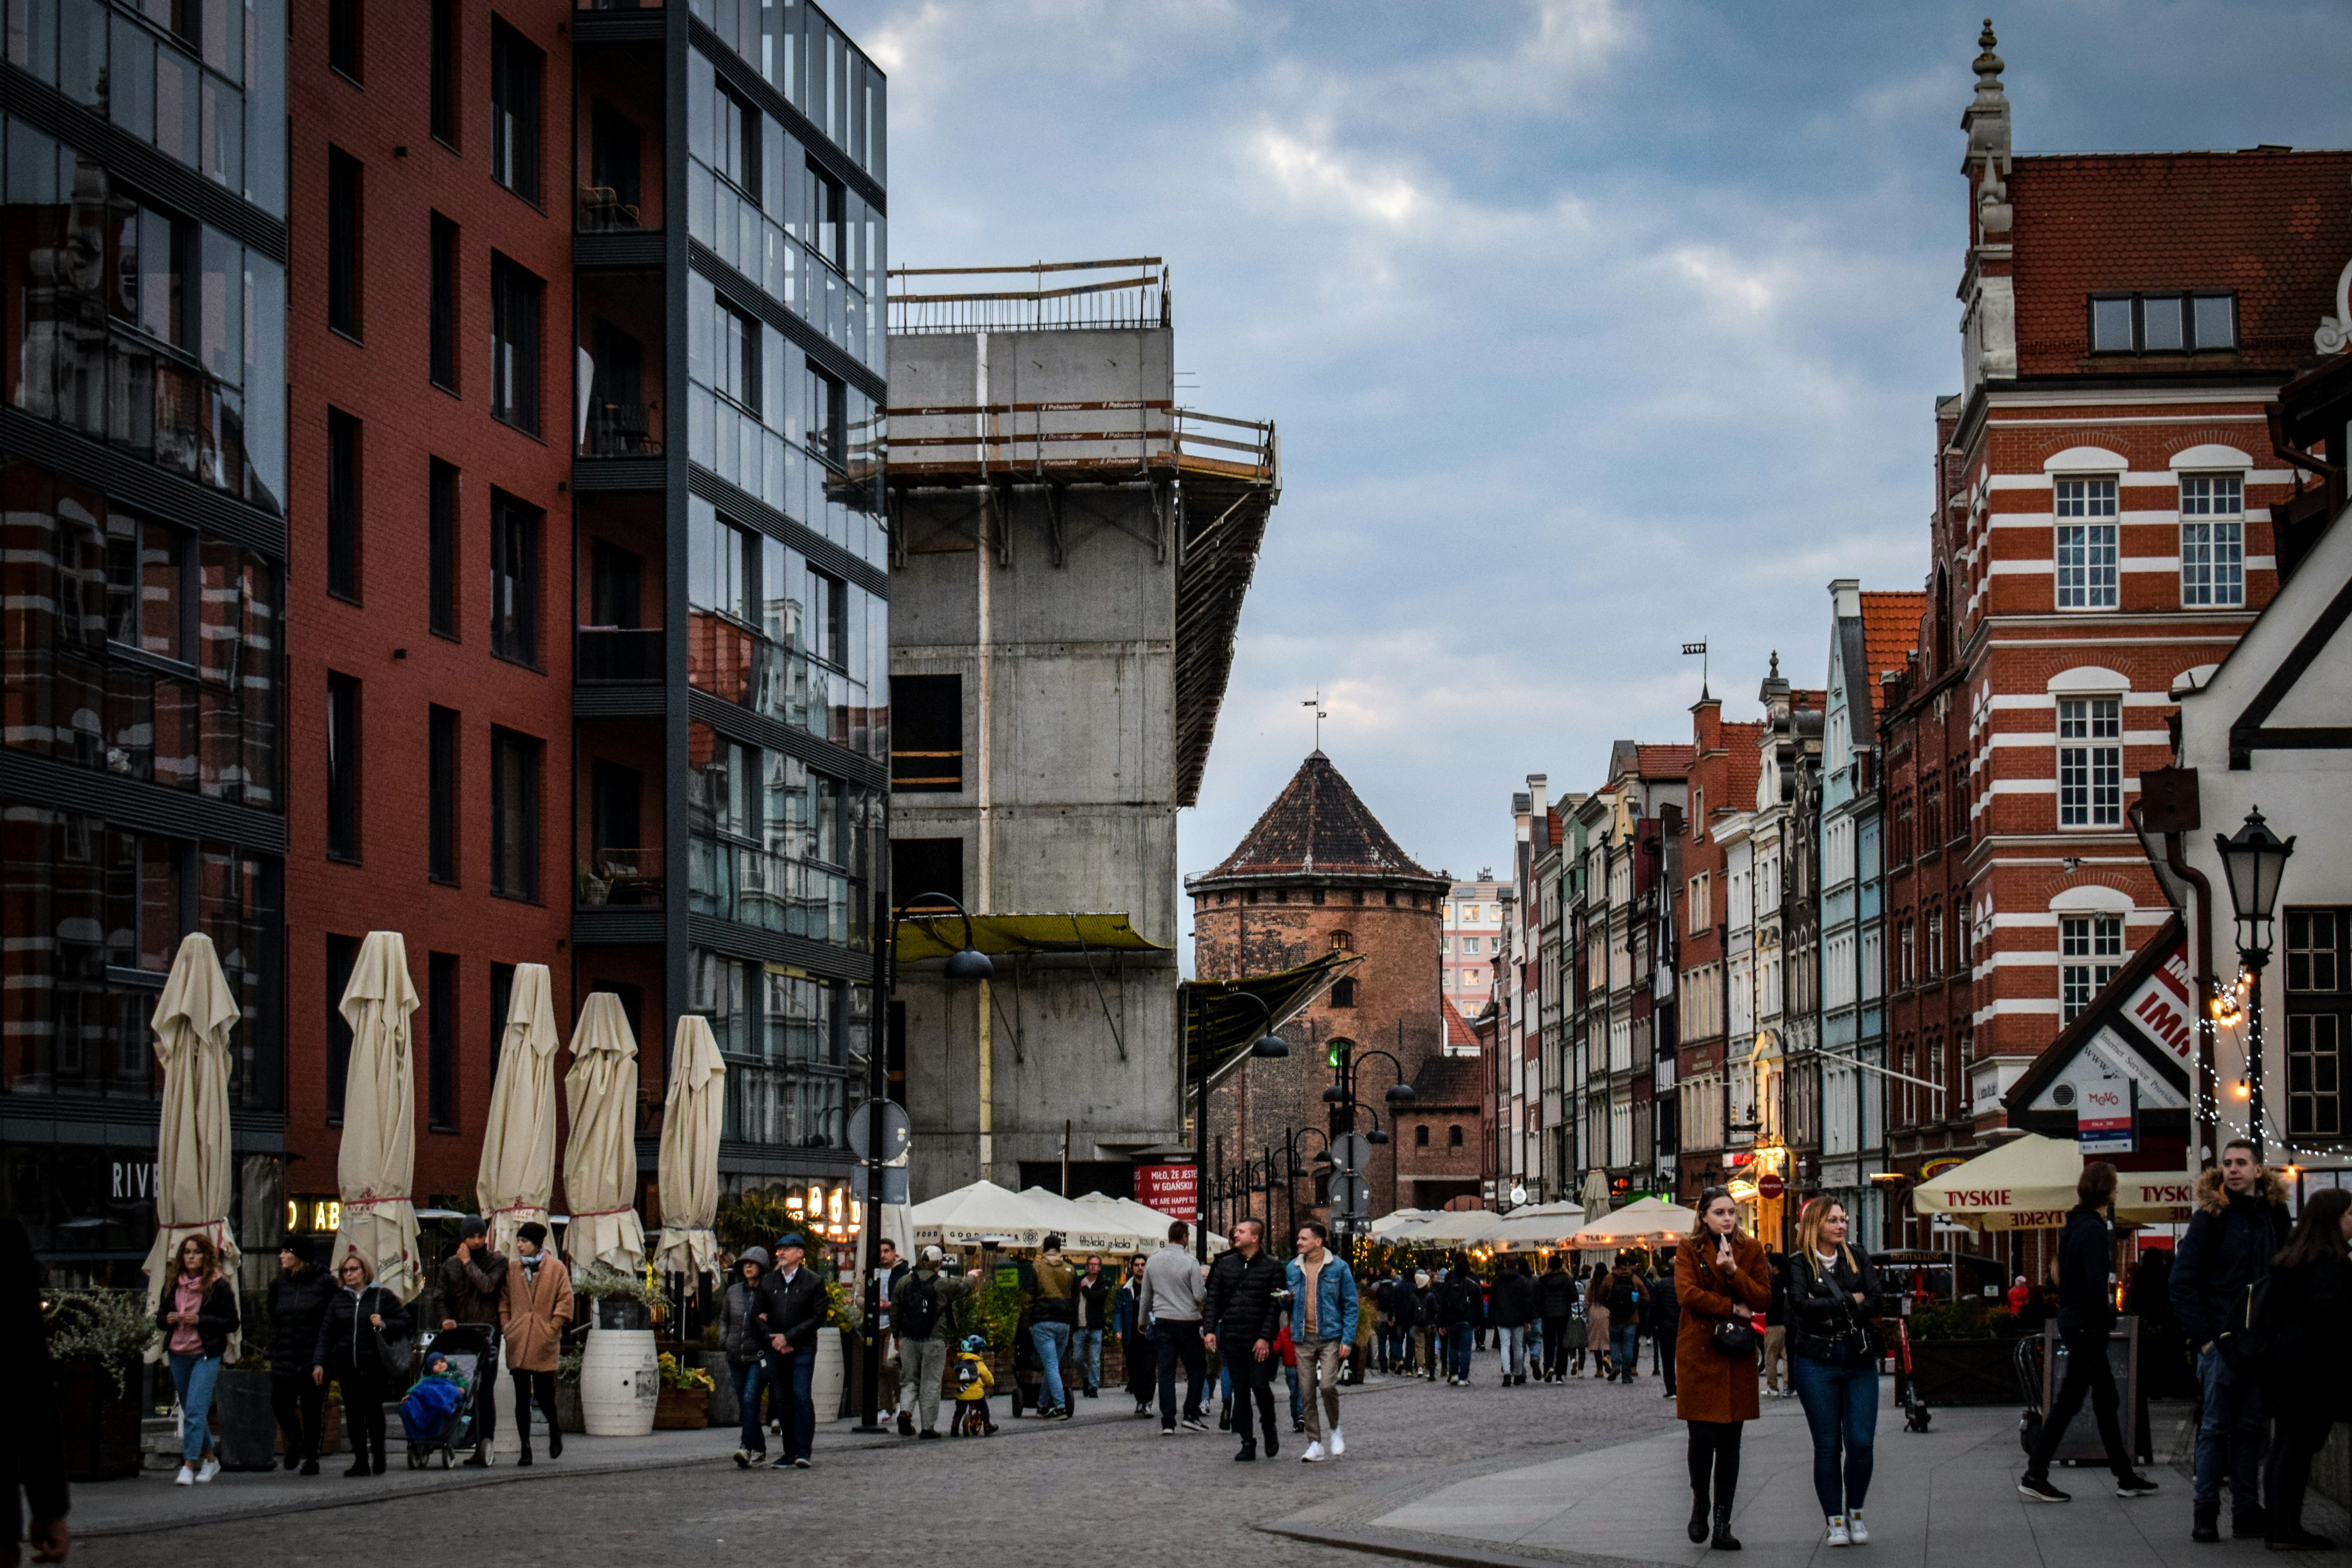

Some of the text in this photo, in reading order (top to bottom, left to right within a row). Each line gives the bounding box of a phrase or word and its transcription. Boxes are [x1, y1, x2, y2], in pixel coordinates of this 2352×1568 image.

[2100, 1033, 2178, 1107] Internet Service Provider
[1151, 1171, 1169, 1180] MIŁO,
[1171, 1169, 1179, 1179] ŻE
[1152, 1182, 1160, 1191] W
[1944, 1189, 2012, 1207] TYSKIE
